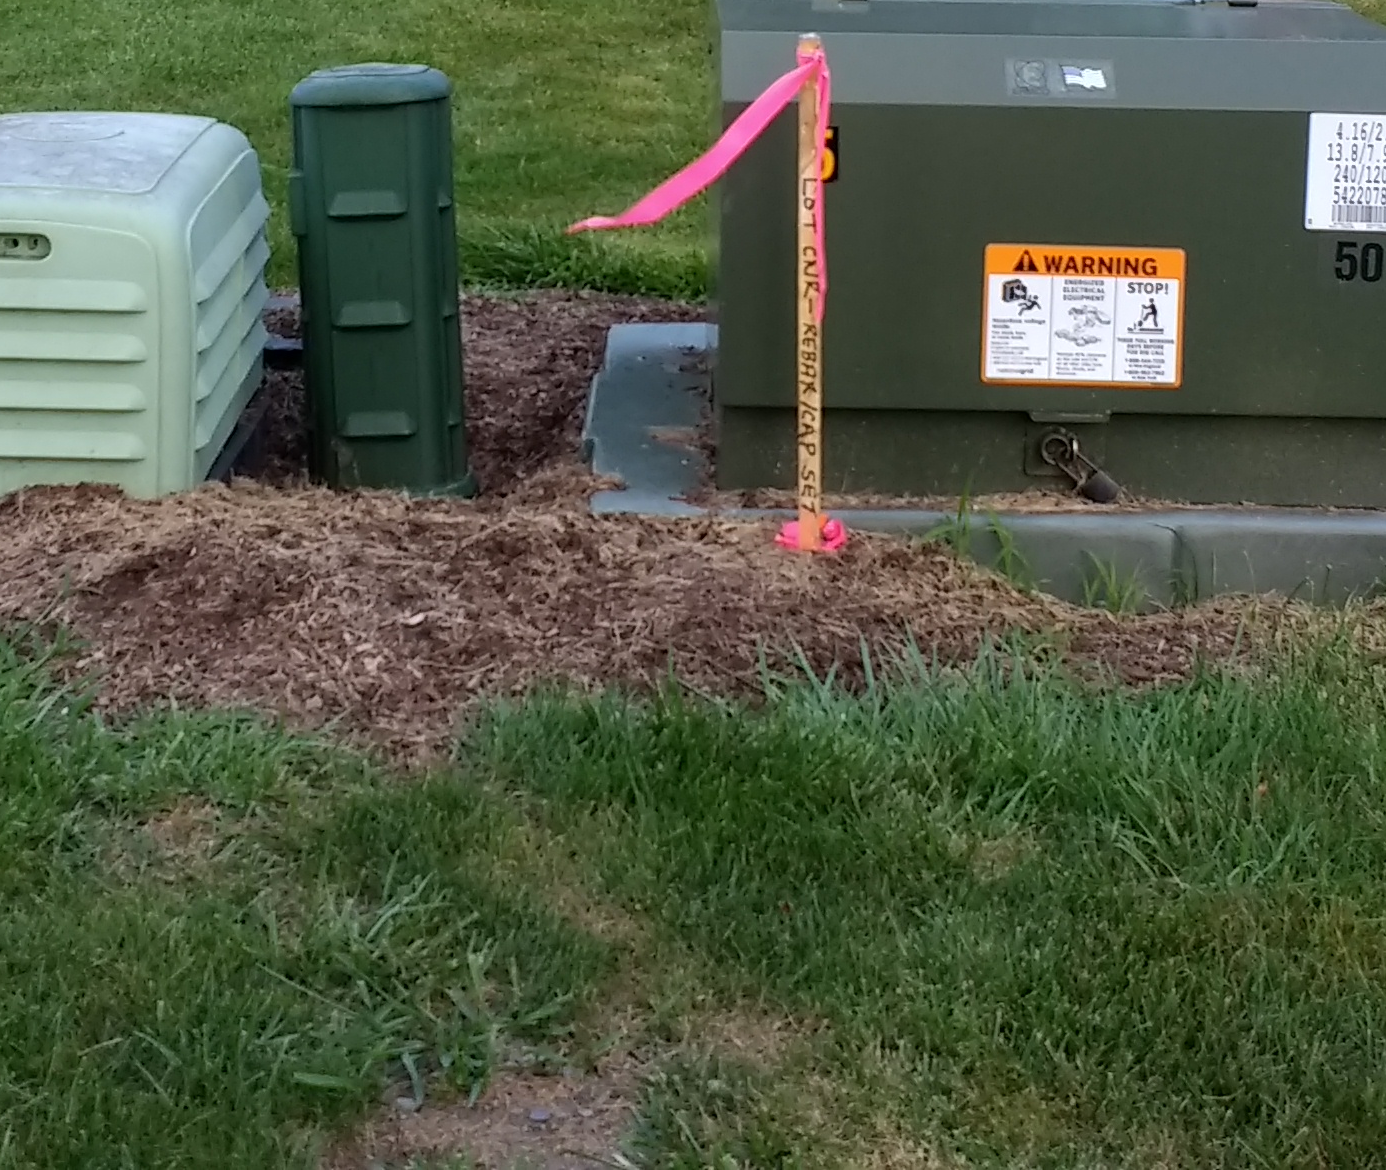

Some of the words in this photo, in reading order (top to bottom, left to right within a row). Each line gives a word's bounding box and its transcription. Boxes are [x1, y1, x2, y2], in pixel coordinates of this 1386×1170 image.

[802, 177, 818, 235] LOT
[1043, 255, 1158, 276] WARNING
[1334, 241, 1384, 283] 50
[1127, 282, 1169, 295] STOP!
[800, 466, 818, 520] SET
